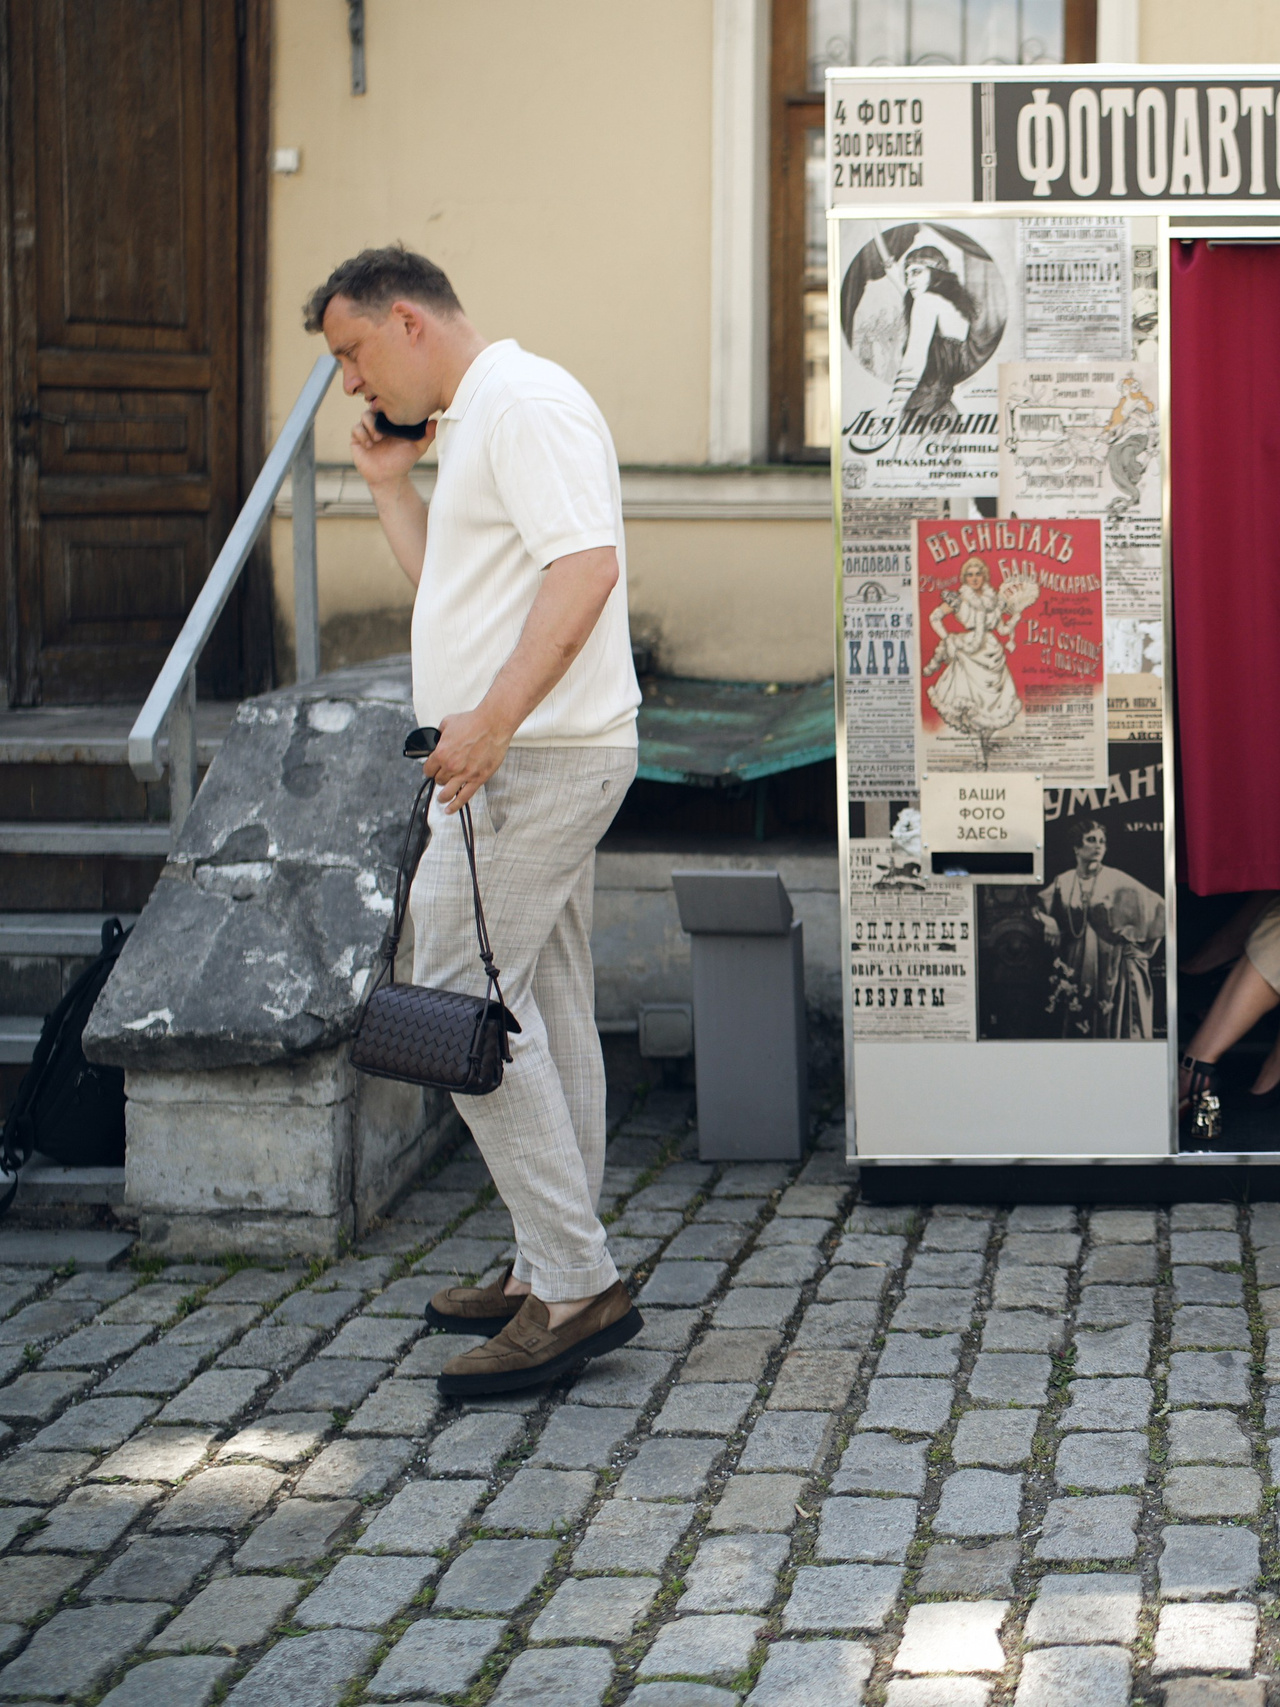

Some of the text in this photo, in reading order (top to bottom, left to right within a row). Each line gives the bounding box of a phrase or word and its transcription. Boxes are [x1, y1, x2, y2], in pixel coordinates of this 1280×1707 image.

[834, 98, 923, 125] 4 ФОТО
[833, 129, 923, 157] 300 РУБЛЕЙ
[834, 162, 923, 187] 2 МИНУТЫ
[925, 529, 961, 564] ВЪ
[842, 554, 899, 575] ОНДОВОЙ
[997, 558, 1037, 585] БАЛЪ
[1039, 567, 1101, 595] МАСКАРАДЪ
[849, 641, 910, 675] КАРА
[958, 788, 1007, 802] ВАШИ
[959, 807, 1006, 821] ФОТО
[956, 826, 1009, 841] ЗДЕСЬ
[868, 942, 931, 954] ПОДАРКИ
[889, 964, 902, 977] СЪ
